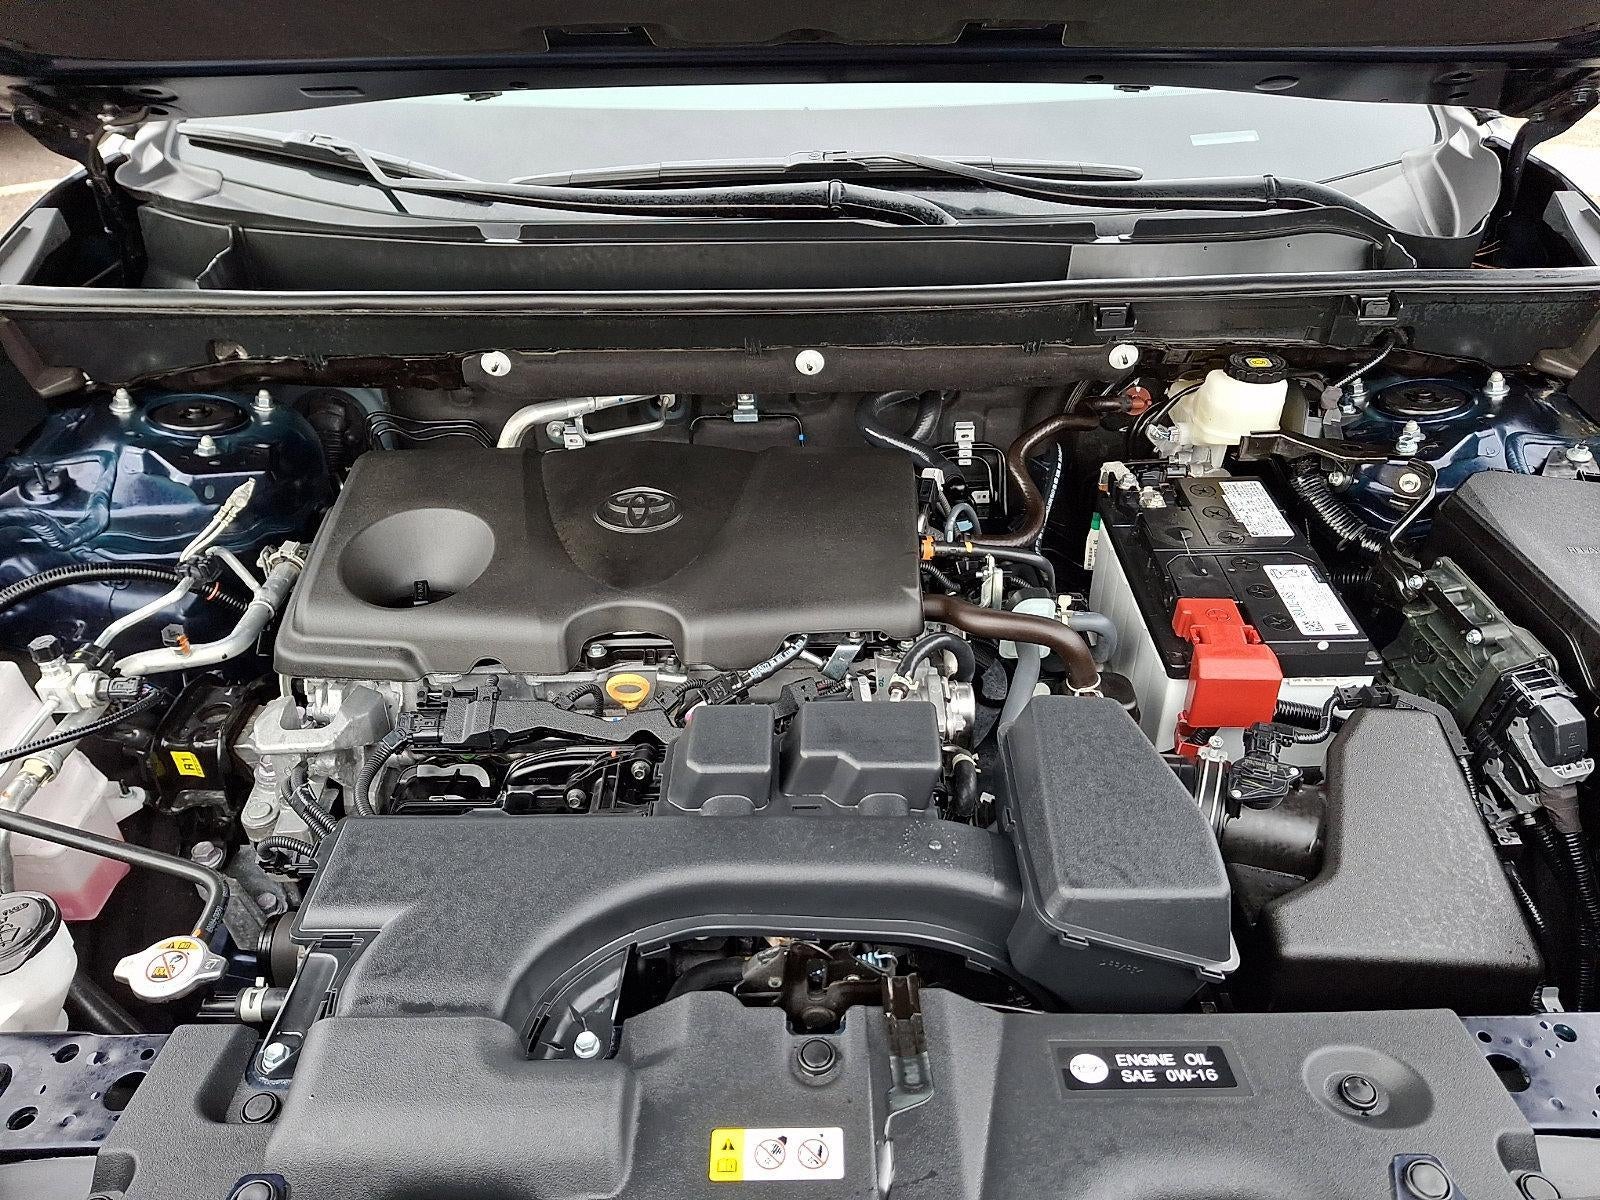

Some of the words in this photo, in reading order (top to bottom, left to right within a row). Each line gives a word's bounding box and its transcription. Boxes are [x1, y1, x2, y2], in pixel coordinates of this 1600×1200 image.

[1114, 1053, 1176, 1067] ENGINE
[1183, 1053, 1213, 1066] OIL
[1120, 1069, 1157, 1082] SAE
[1165, 1069, 1219, 1082] 0W-16
